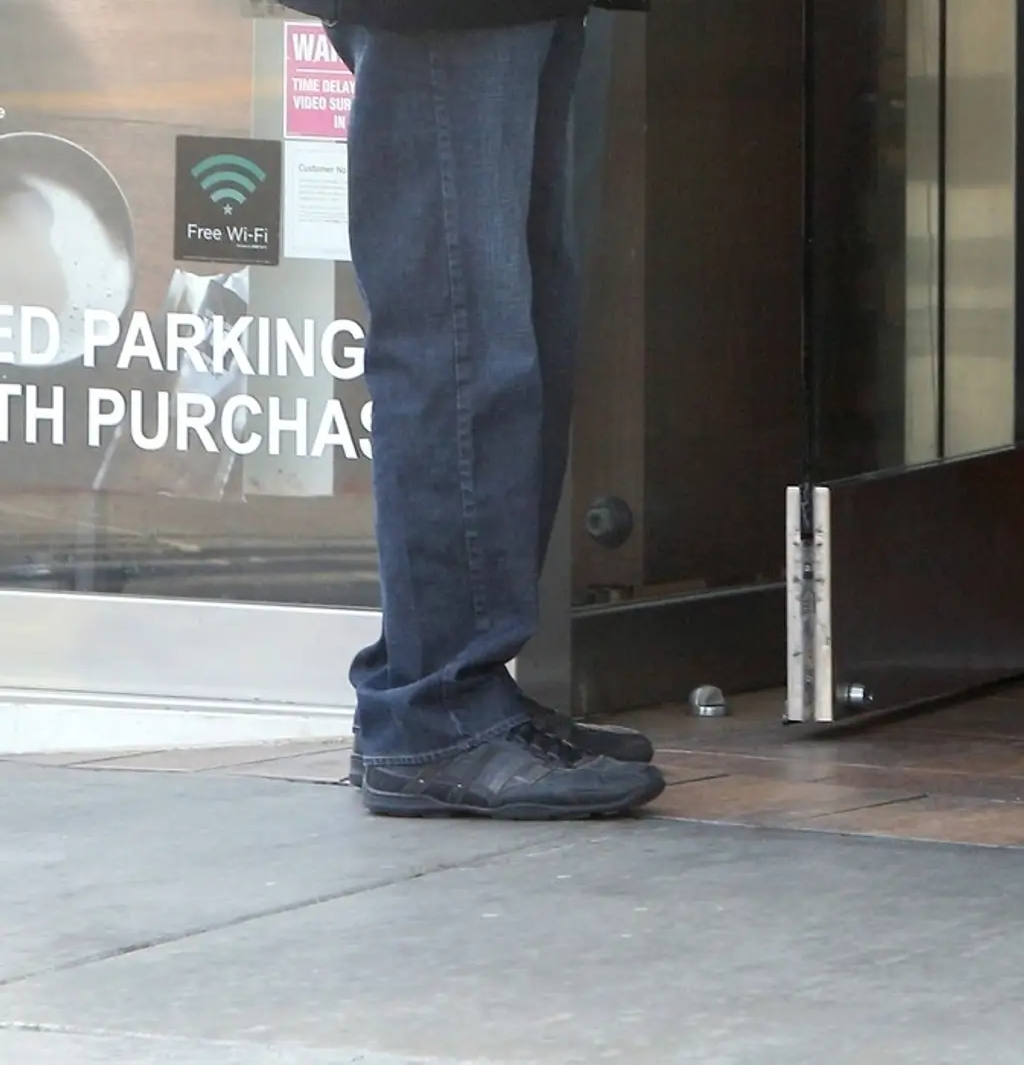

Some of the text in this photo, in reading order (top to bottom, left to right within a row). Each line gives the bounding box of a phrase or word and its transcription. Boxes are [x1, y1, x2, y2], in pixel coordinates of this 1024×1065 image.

[292, 77, 356, 94] TIME DELAY
[293, 96, 327, 110] VIDEO
[187, 223, 268, 244] Free Wi-Fi
[83, 309, 366, 380] PARKING
